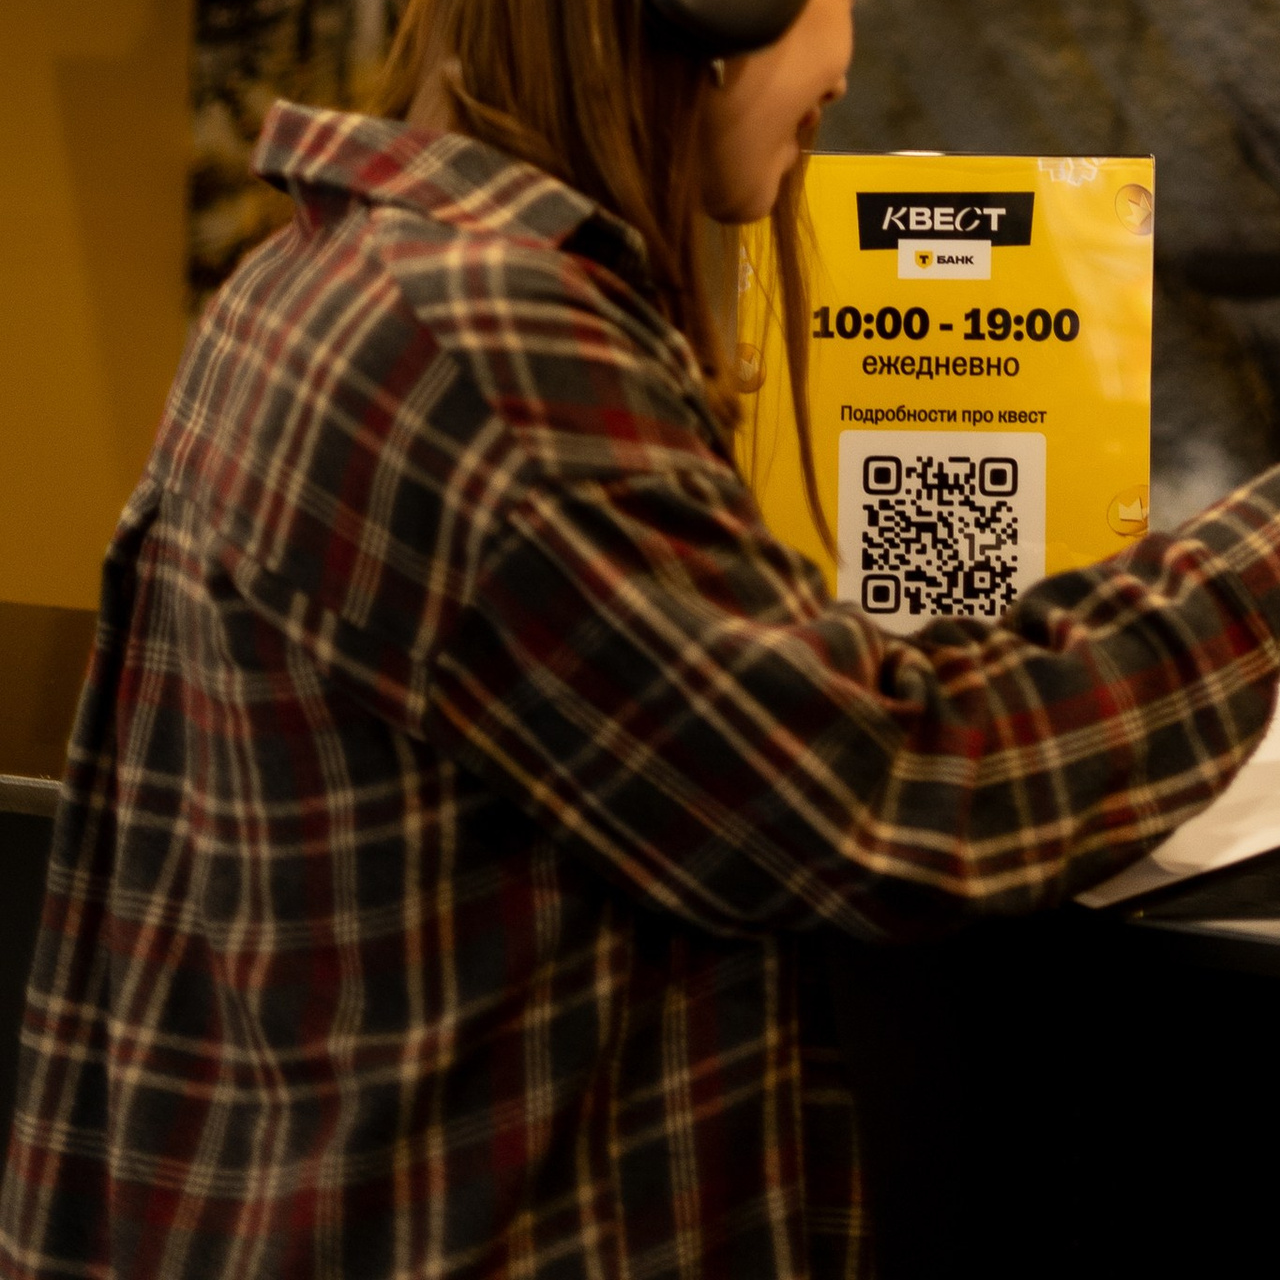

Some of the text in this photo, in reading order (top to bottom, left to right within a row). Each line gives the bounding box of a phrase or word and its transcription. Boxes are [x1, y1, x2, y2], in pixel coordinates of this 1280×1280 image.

[882, 206, 1007, 232] КВЕСТ
[936, 255, 974, 265] БАНК
[812, 306, 930, 340] 10:00
[963, 308, 1080, 342] 19:00
[862, 353, 1020, 380] ежедневно
[840, 404, 1047, 427] Подробности про квест
